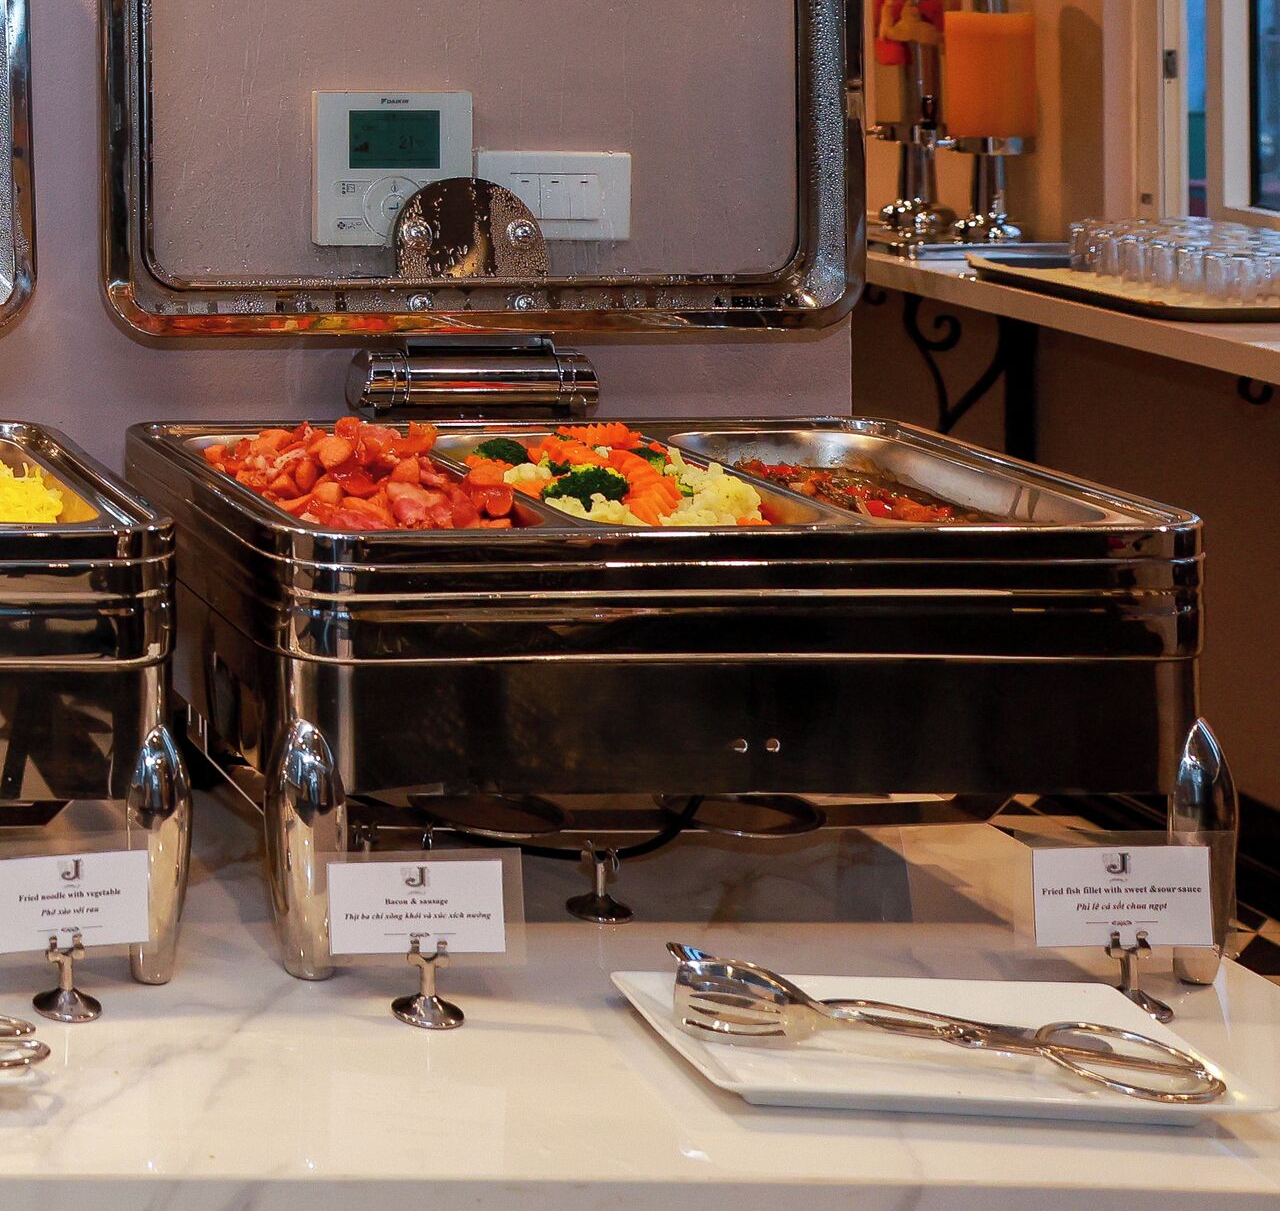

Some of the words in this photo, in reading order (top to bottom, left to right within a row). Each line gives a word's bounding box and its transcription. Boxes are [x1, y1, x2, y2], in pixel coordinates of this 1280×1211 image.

[61, 859, 81, 880] J
[1107, 853, 1129, 874] J
[405, 866, 427, 887] J
[41, 892, 66, 901] noodle
[86, 888, 121, 898] vegetable
[1083, 887, 1102, 895] fillet
[1126, 902, 1146, 910] chua
